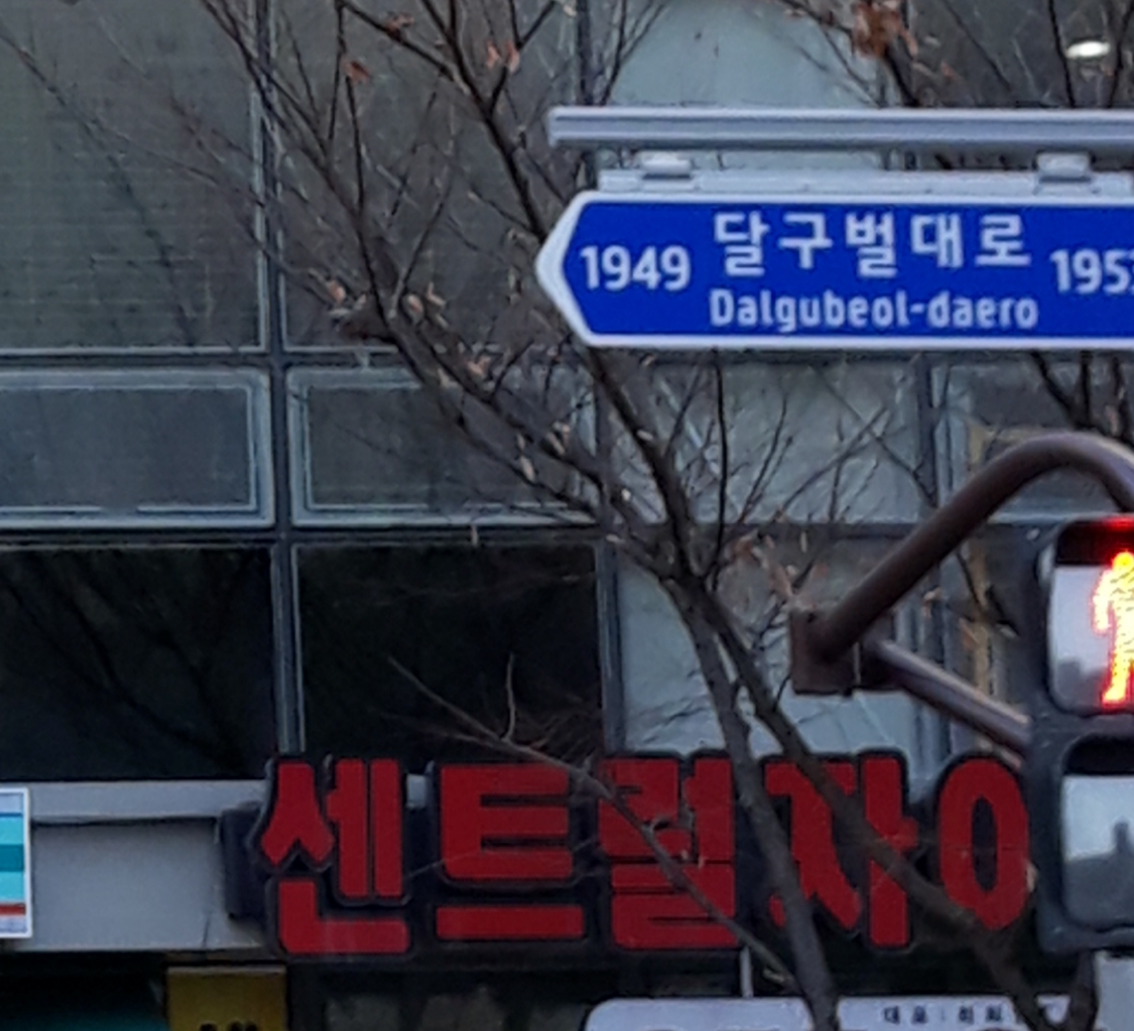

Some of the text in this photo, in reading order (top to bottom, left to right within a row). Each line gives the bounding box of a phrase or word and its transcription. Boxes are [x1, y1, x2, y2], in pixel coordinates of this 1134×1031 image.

[713, 211, 1031, 278] 달구벌대로
[579, 245, 693, 292] 1949
[1049, 248, 1134, 295] 195
[709, 288, 1040, 333] Dalgubeol-daero
